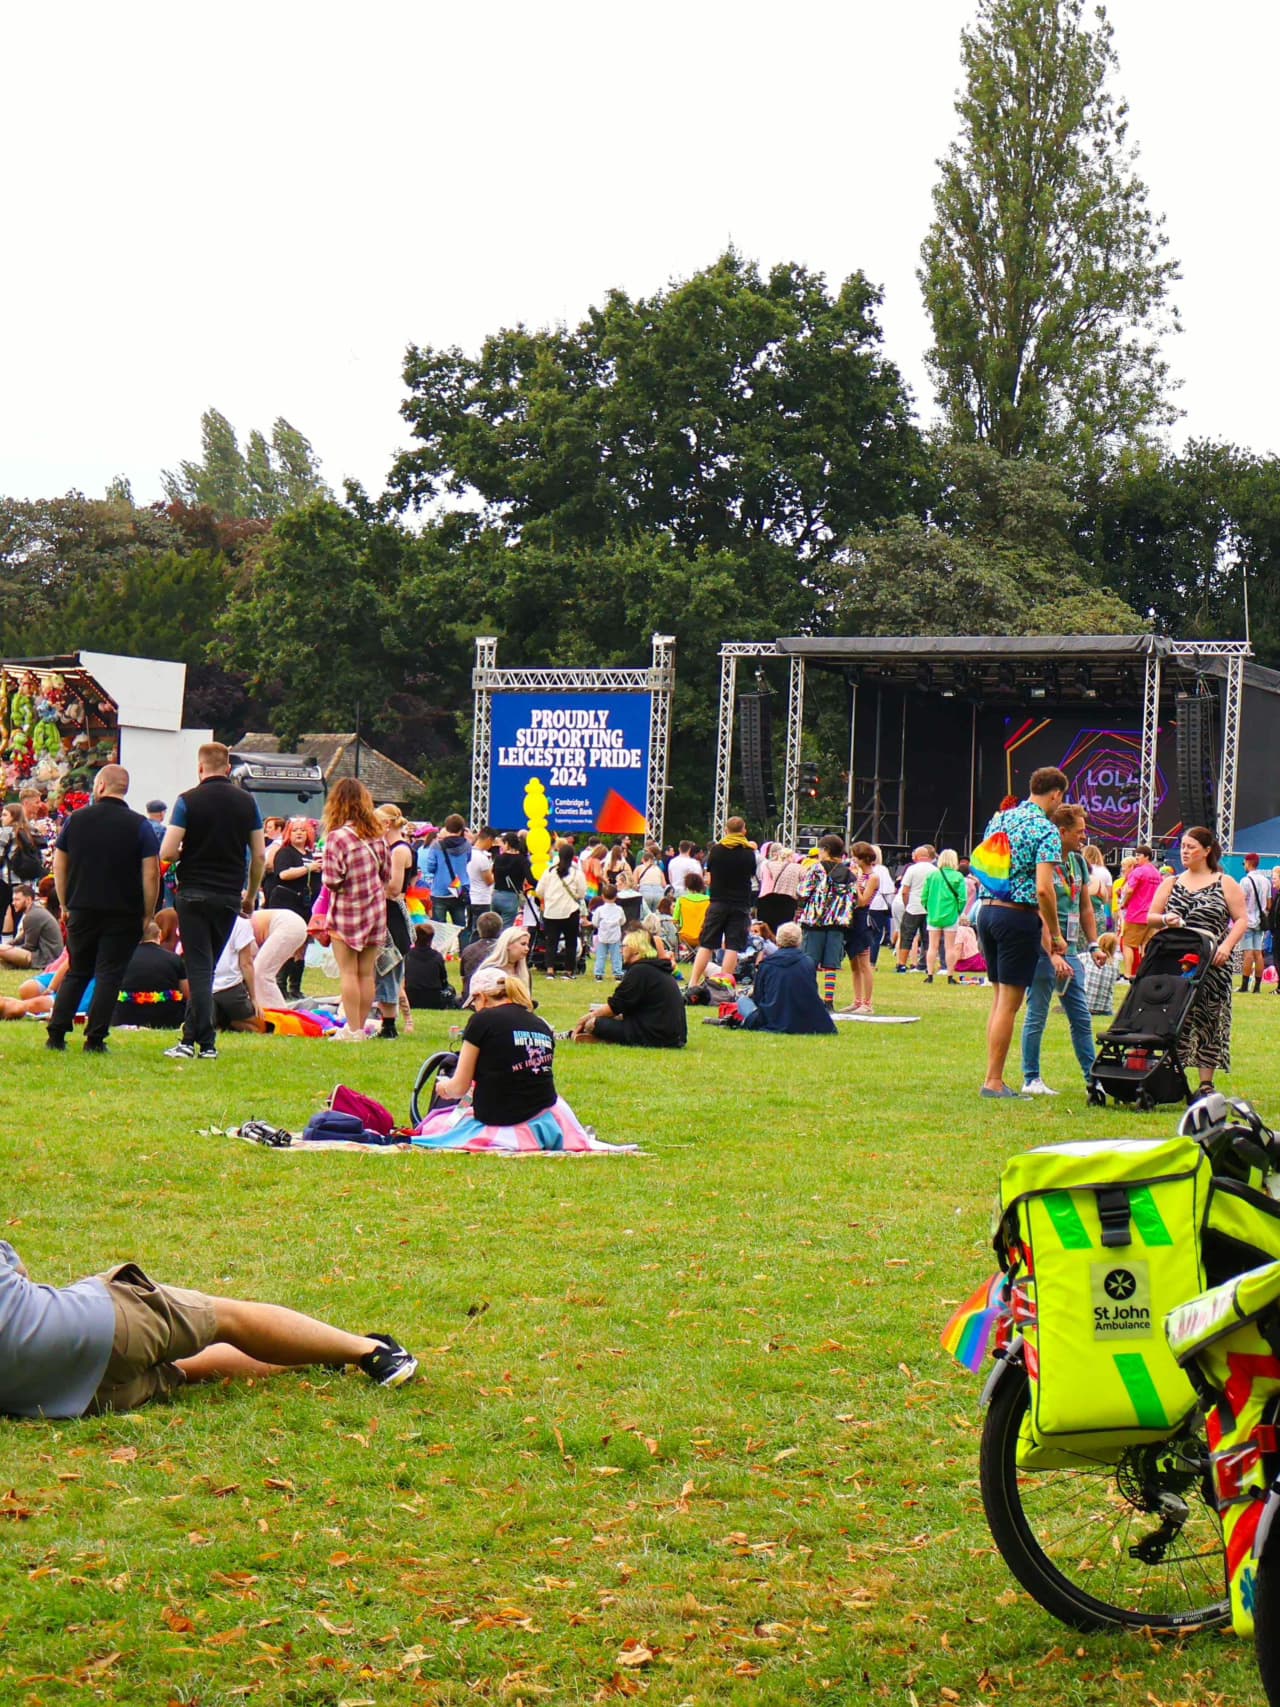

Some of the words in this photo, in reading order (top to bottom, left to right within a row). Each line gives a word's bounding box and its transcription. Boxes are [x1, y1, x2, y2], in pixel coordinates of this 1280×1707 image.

[531, 709, 610, 729] PROUDLY
[516, 728, 623, 749] SUPPORTING
[498, 747, 586, 767] LEICESTER
[589, 748, 641, 768] PRIDE
[550, 767, 587, 786] 2024
[1094, 1306, 1110, 1321] St
[1113, 1305, 1150, 1320] John
[1095, 1321, 1151, 1331] Ambulance
